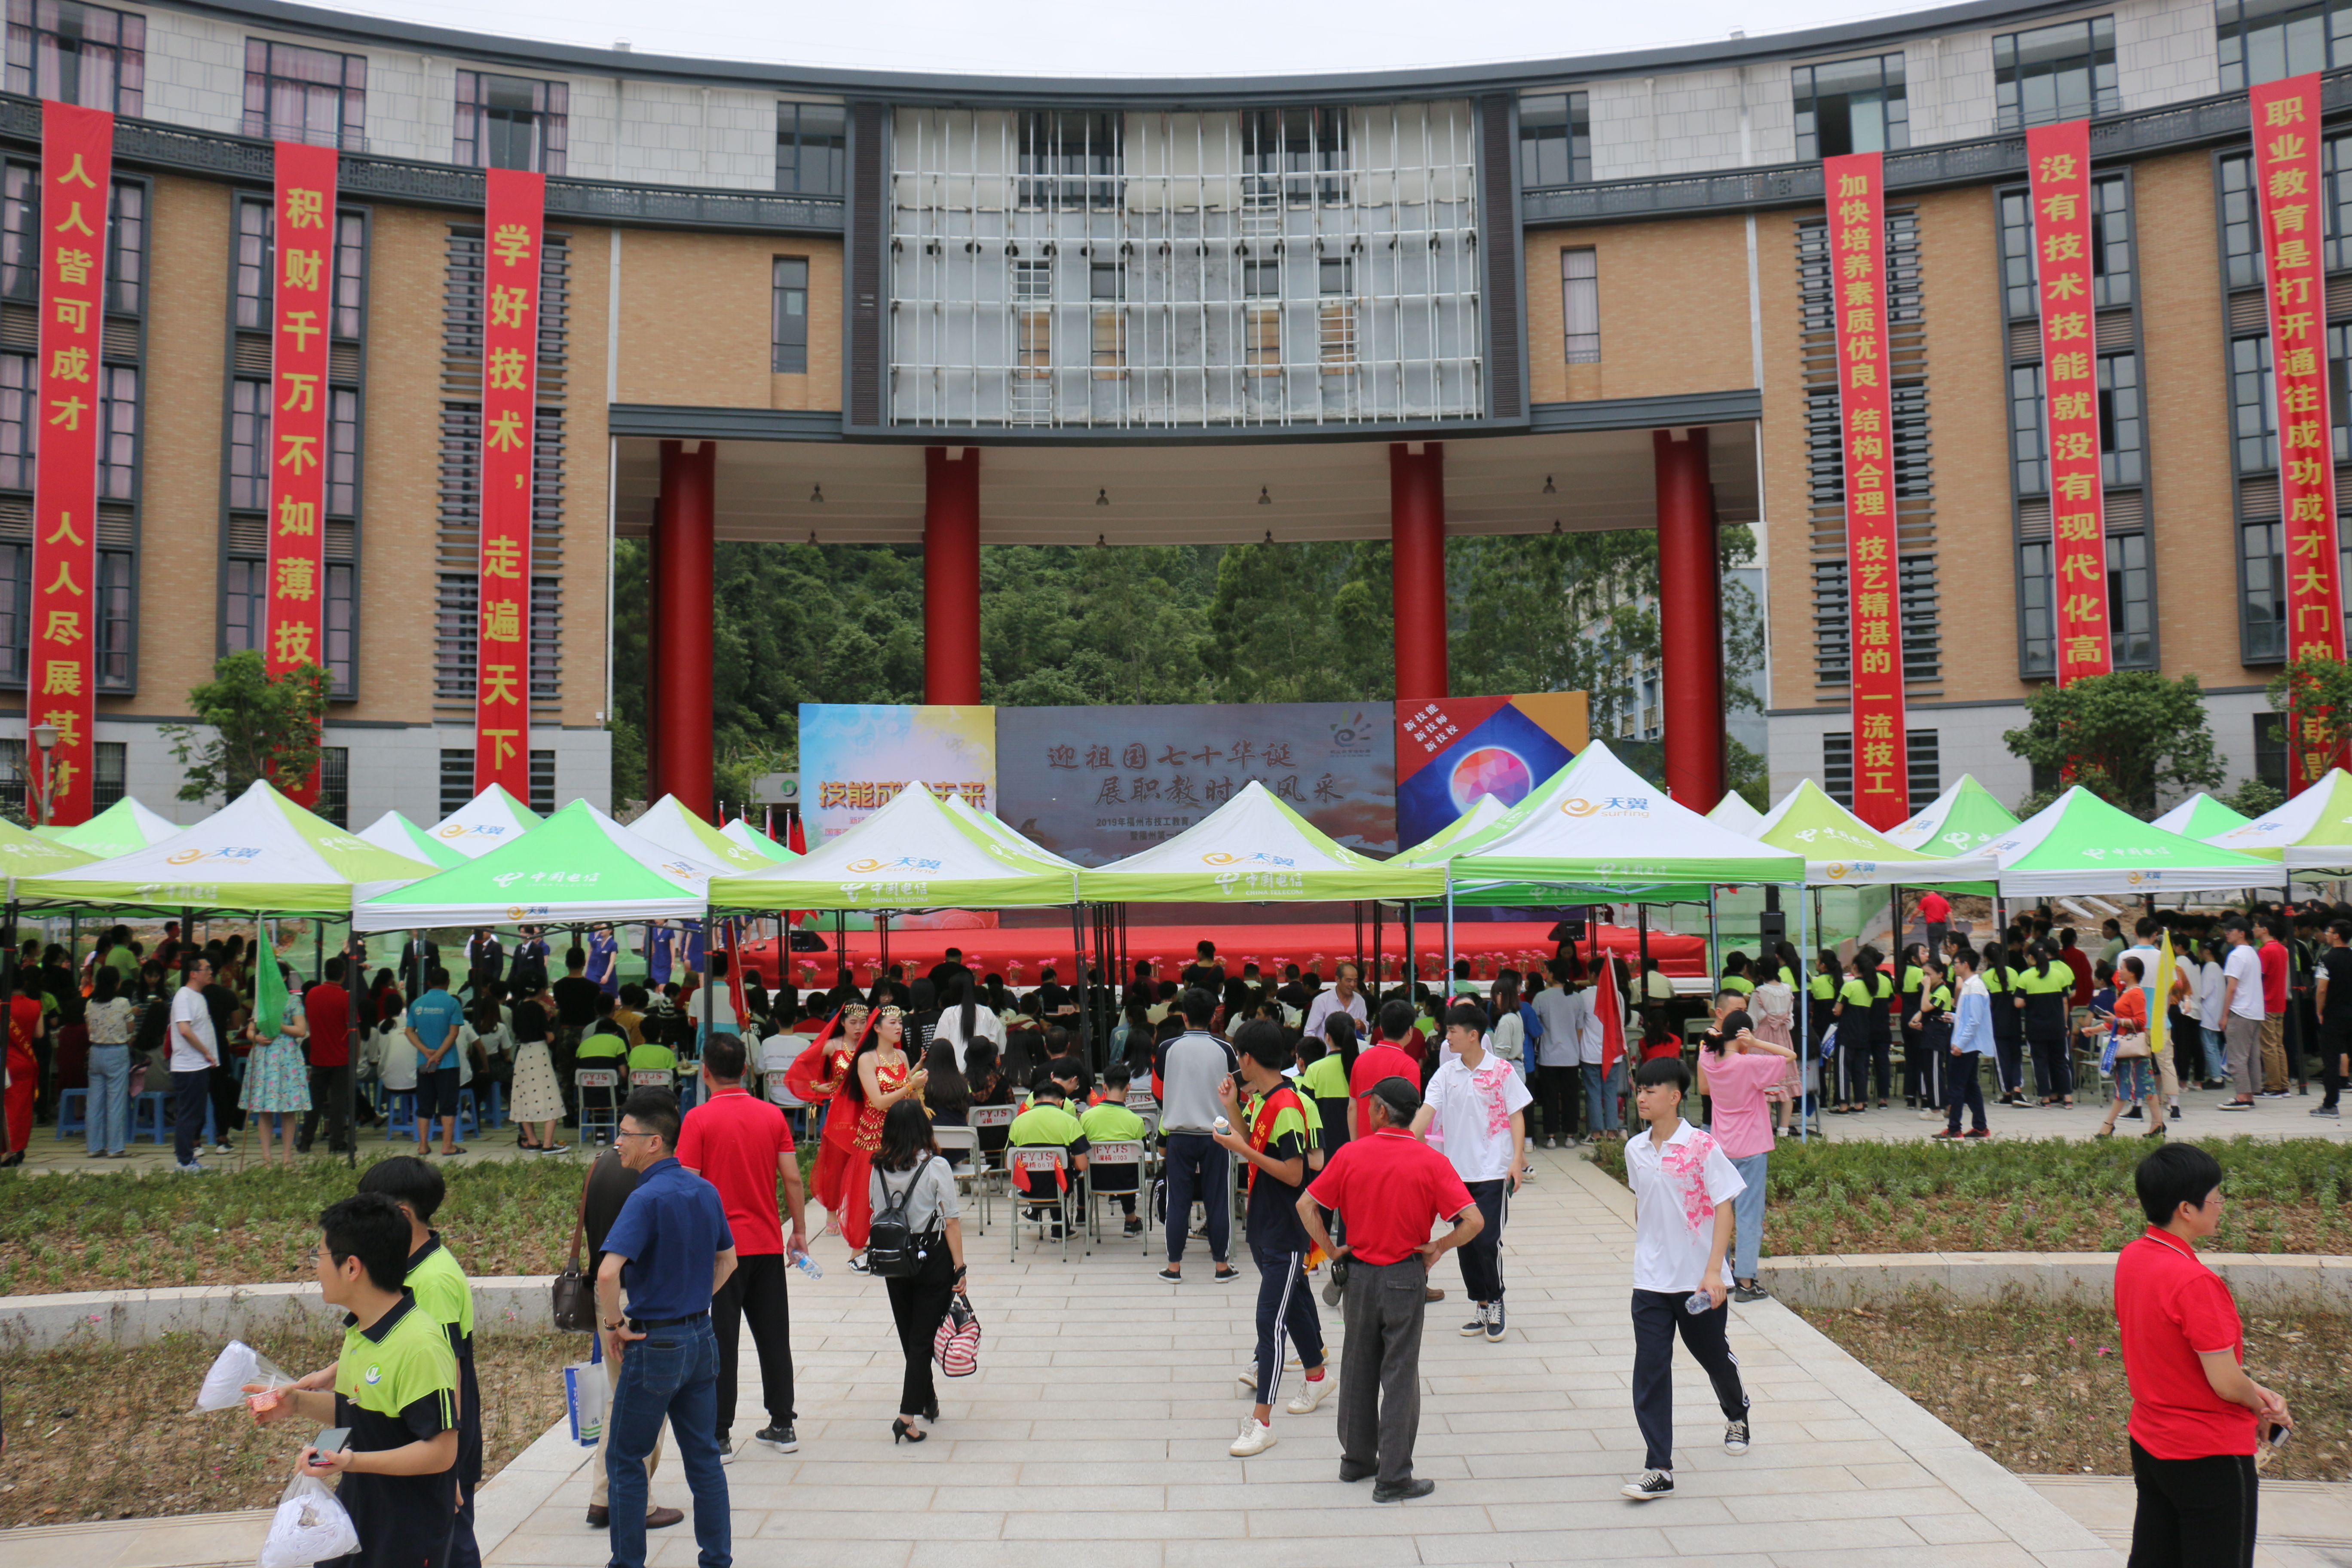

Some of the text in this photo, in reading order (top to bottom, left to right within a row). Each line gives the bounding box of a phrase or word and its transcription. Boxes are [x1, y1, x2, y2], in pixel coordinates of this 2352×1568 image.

[49, 153, 96, 431] 人人皆可成才
[2264, 96, 2335, 781] 职业教育是打开通往成功成才大门的钥匙
[482, 224, 531, 769] 学好技术，走遍天下
[43, 511, 85, 796] 人人尽展其才
[1403, 704, 1439, 732] 新技能
[1414, 714, 1447, 742] 新技师
[1424, 725, 1458, 752] 新技校
[1047, 739, 1297, 771] 迎祖国七十华诞
[818, 781, 986, 809] 技能成未来
[1094, 772, 1344, 806] 展职教时风采
[1603, 797, 1649, 810] 天翼
[1601, 810, 1649, 818] surfing
[1096, 817, 1209, 827] 2019年福州市技工教育、
[469, 825, 505, 835] 天翼
[208, 847, 263, 859] 天翼
[2112, 846, 2171, 856] 中国电信
[889, 857, 941, 870] 天翼
[1246, 852, 1295, 867] 天翼
[1850, 862, 1875, 872] 天翼
[530, 871, 600, 882] 中国电信
[1246, 873, 1303, 889] 中国电信
[165, 885, 217, 899] 中国电信
[870, 882, 928, 897] 中国电信
[526, 906, 548, 915] 天翼
[980, 1109, 1007, 1118] FYJS
[1096, 1144, 1128, 1154] FYJS
[1020, 1152, 1054, 1161] FYJS
